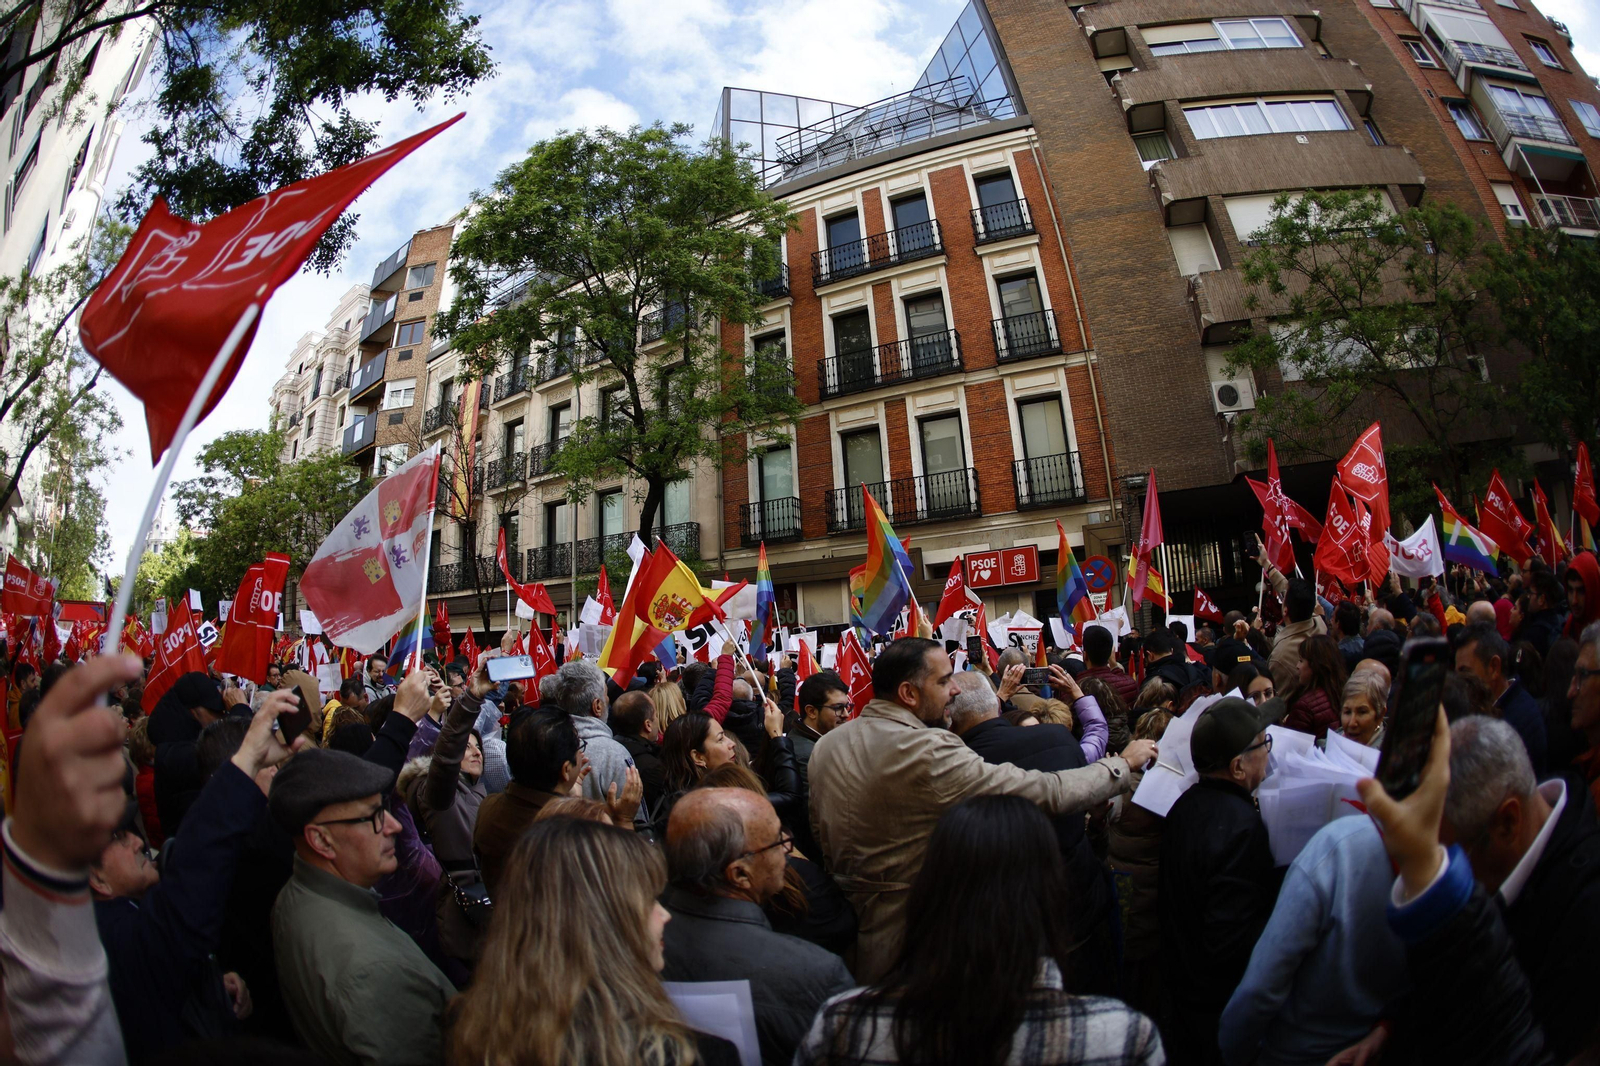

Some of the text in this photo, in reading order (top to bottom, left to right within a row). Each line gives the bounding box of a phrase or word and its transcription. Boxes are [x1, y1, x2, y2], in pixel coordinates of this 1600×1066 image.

[971, 557, 997, 570] PSOE
[6, 573, 27, 588] PSOE
[260, 590, 283, 613] OE
[1008, 632, 1039, 648] SNCHEZ
